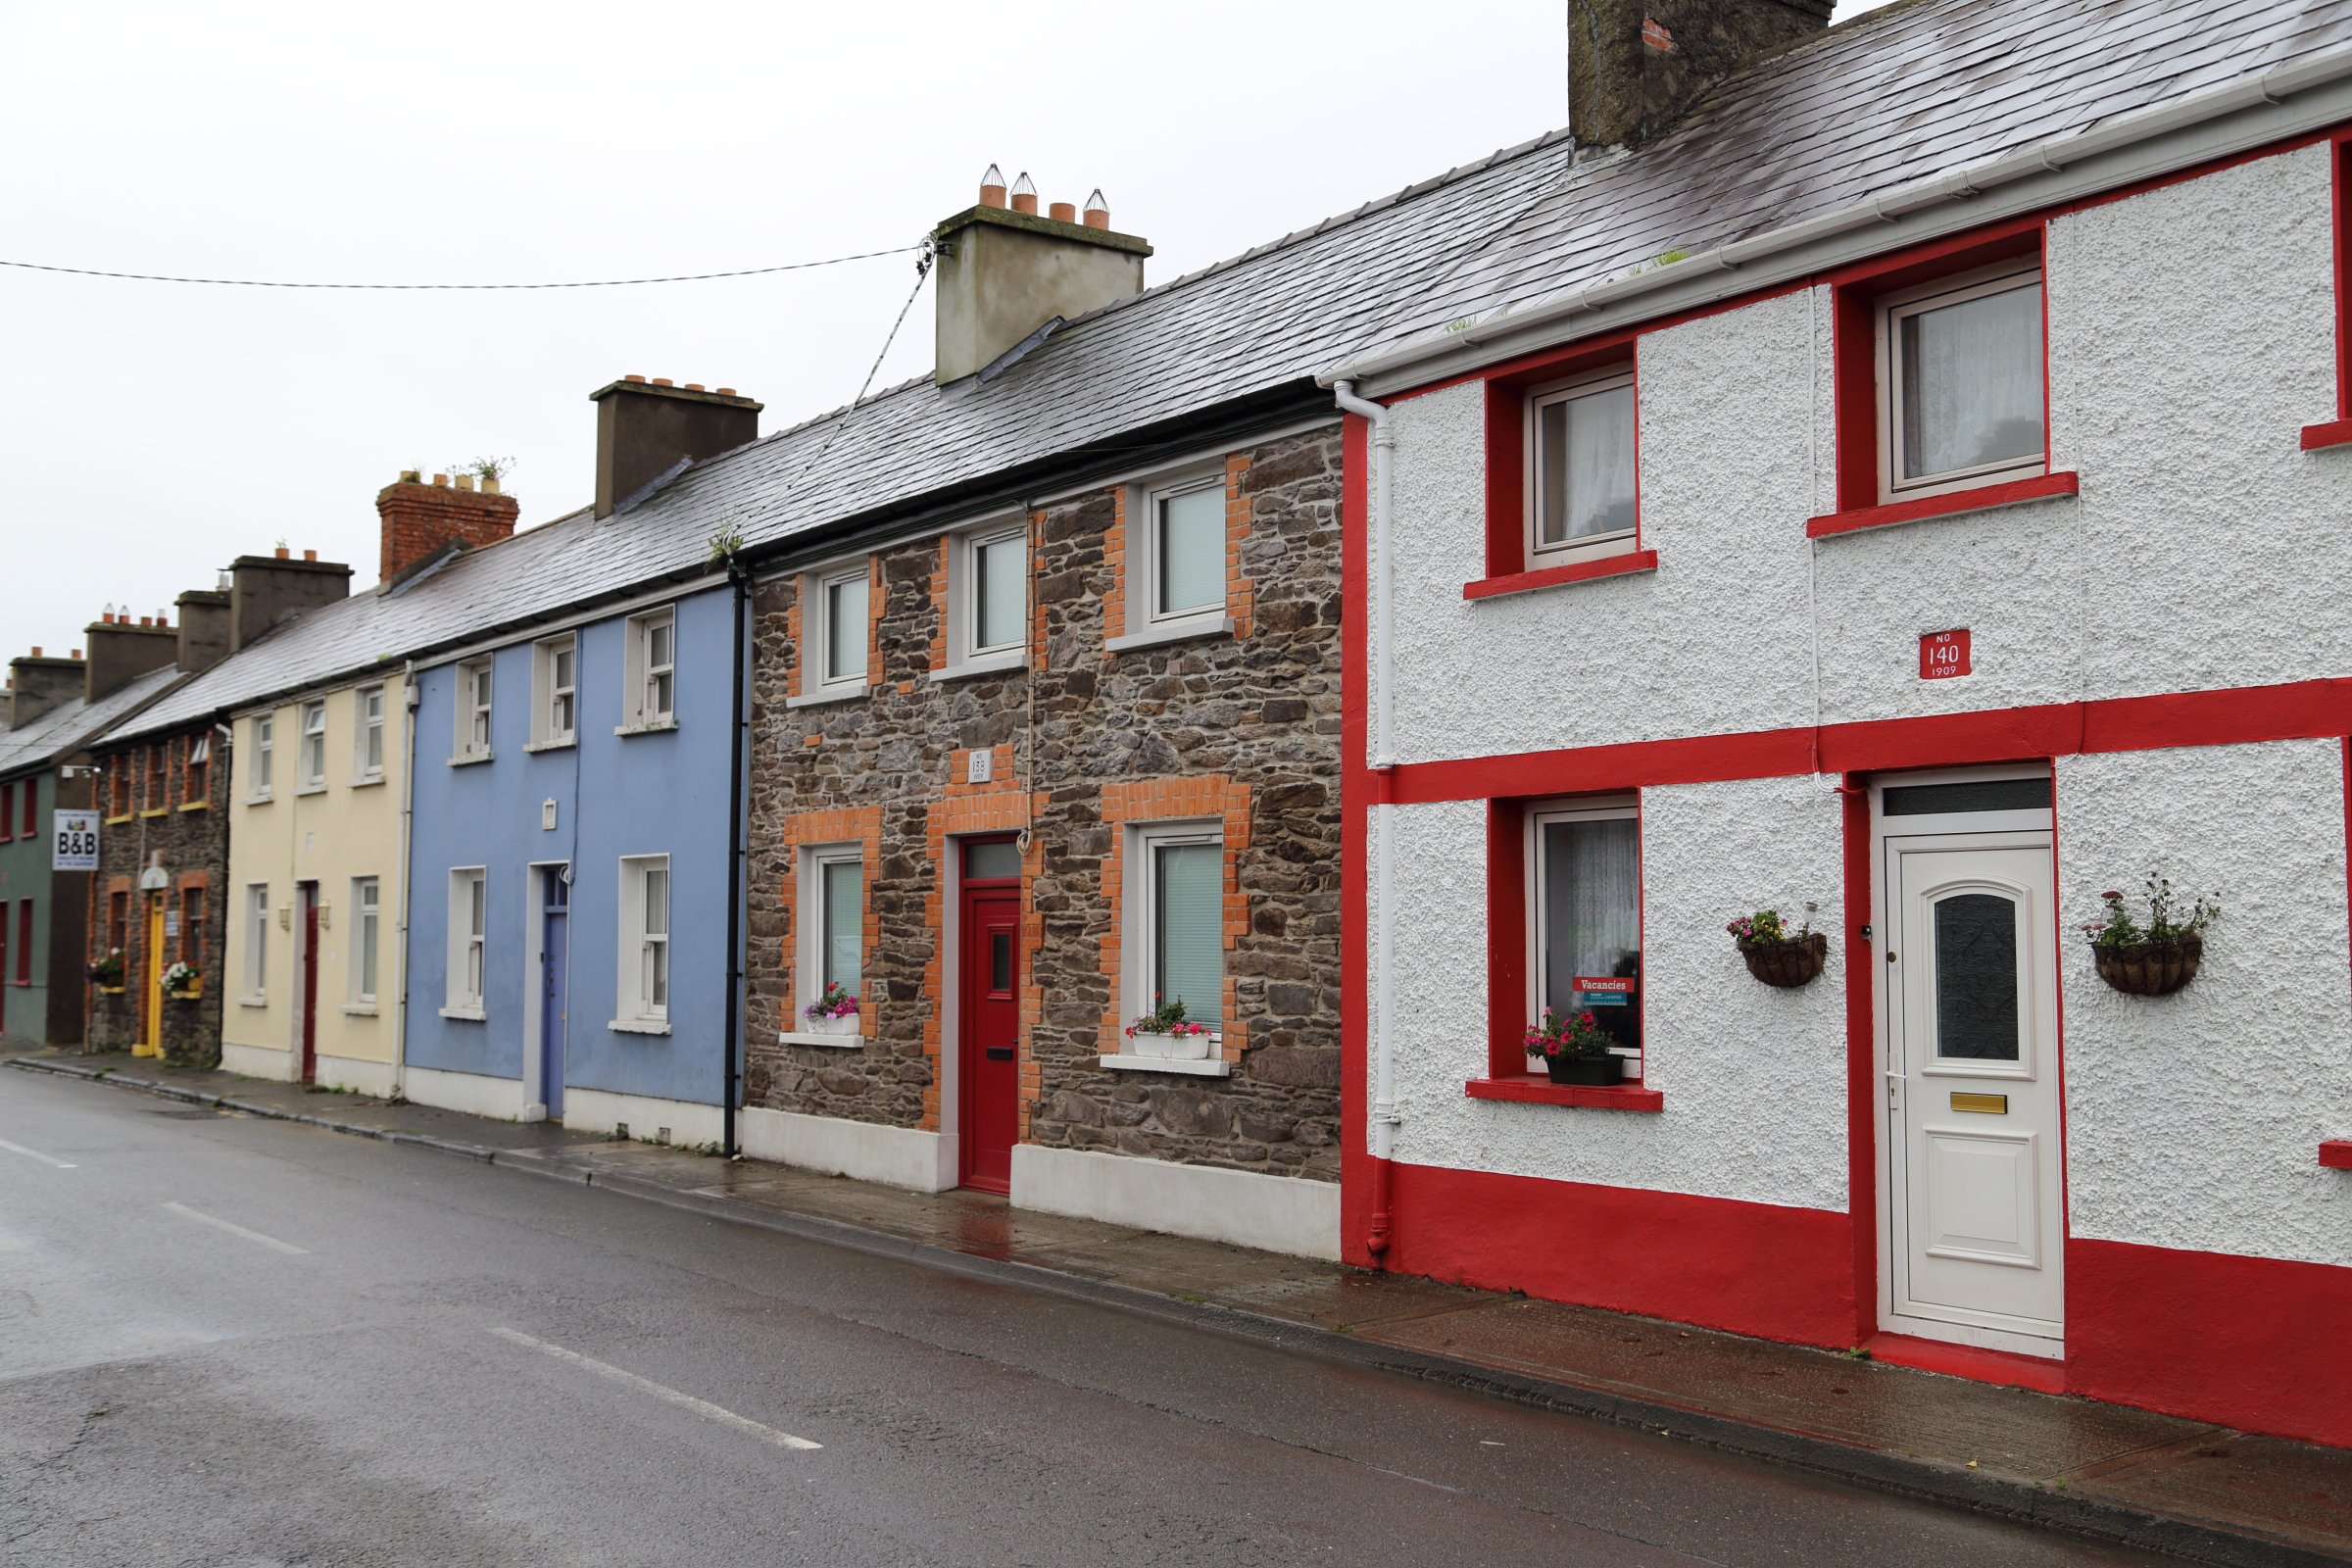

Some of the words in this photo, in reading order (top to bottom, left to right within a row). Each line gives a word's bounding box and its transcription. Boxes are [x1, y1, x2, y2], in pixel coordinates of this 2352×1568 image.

[1936, 633, 1950, 643] NO
[1930, 645, 1959, 665] 140
[1932, 665, 1956, 676] 1909
[972, 760, 985, 772] 138
[59, 832, 96, 855] B&B
[1581, 979, 1627, 990] Vacancies
